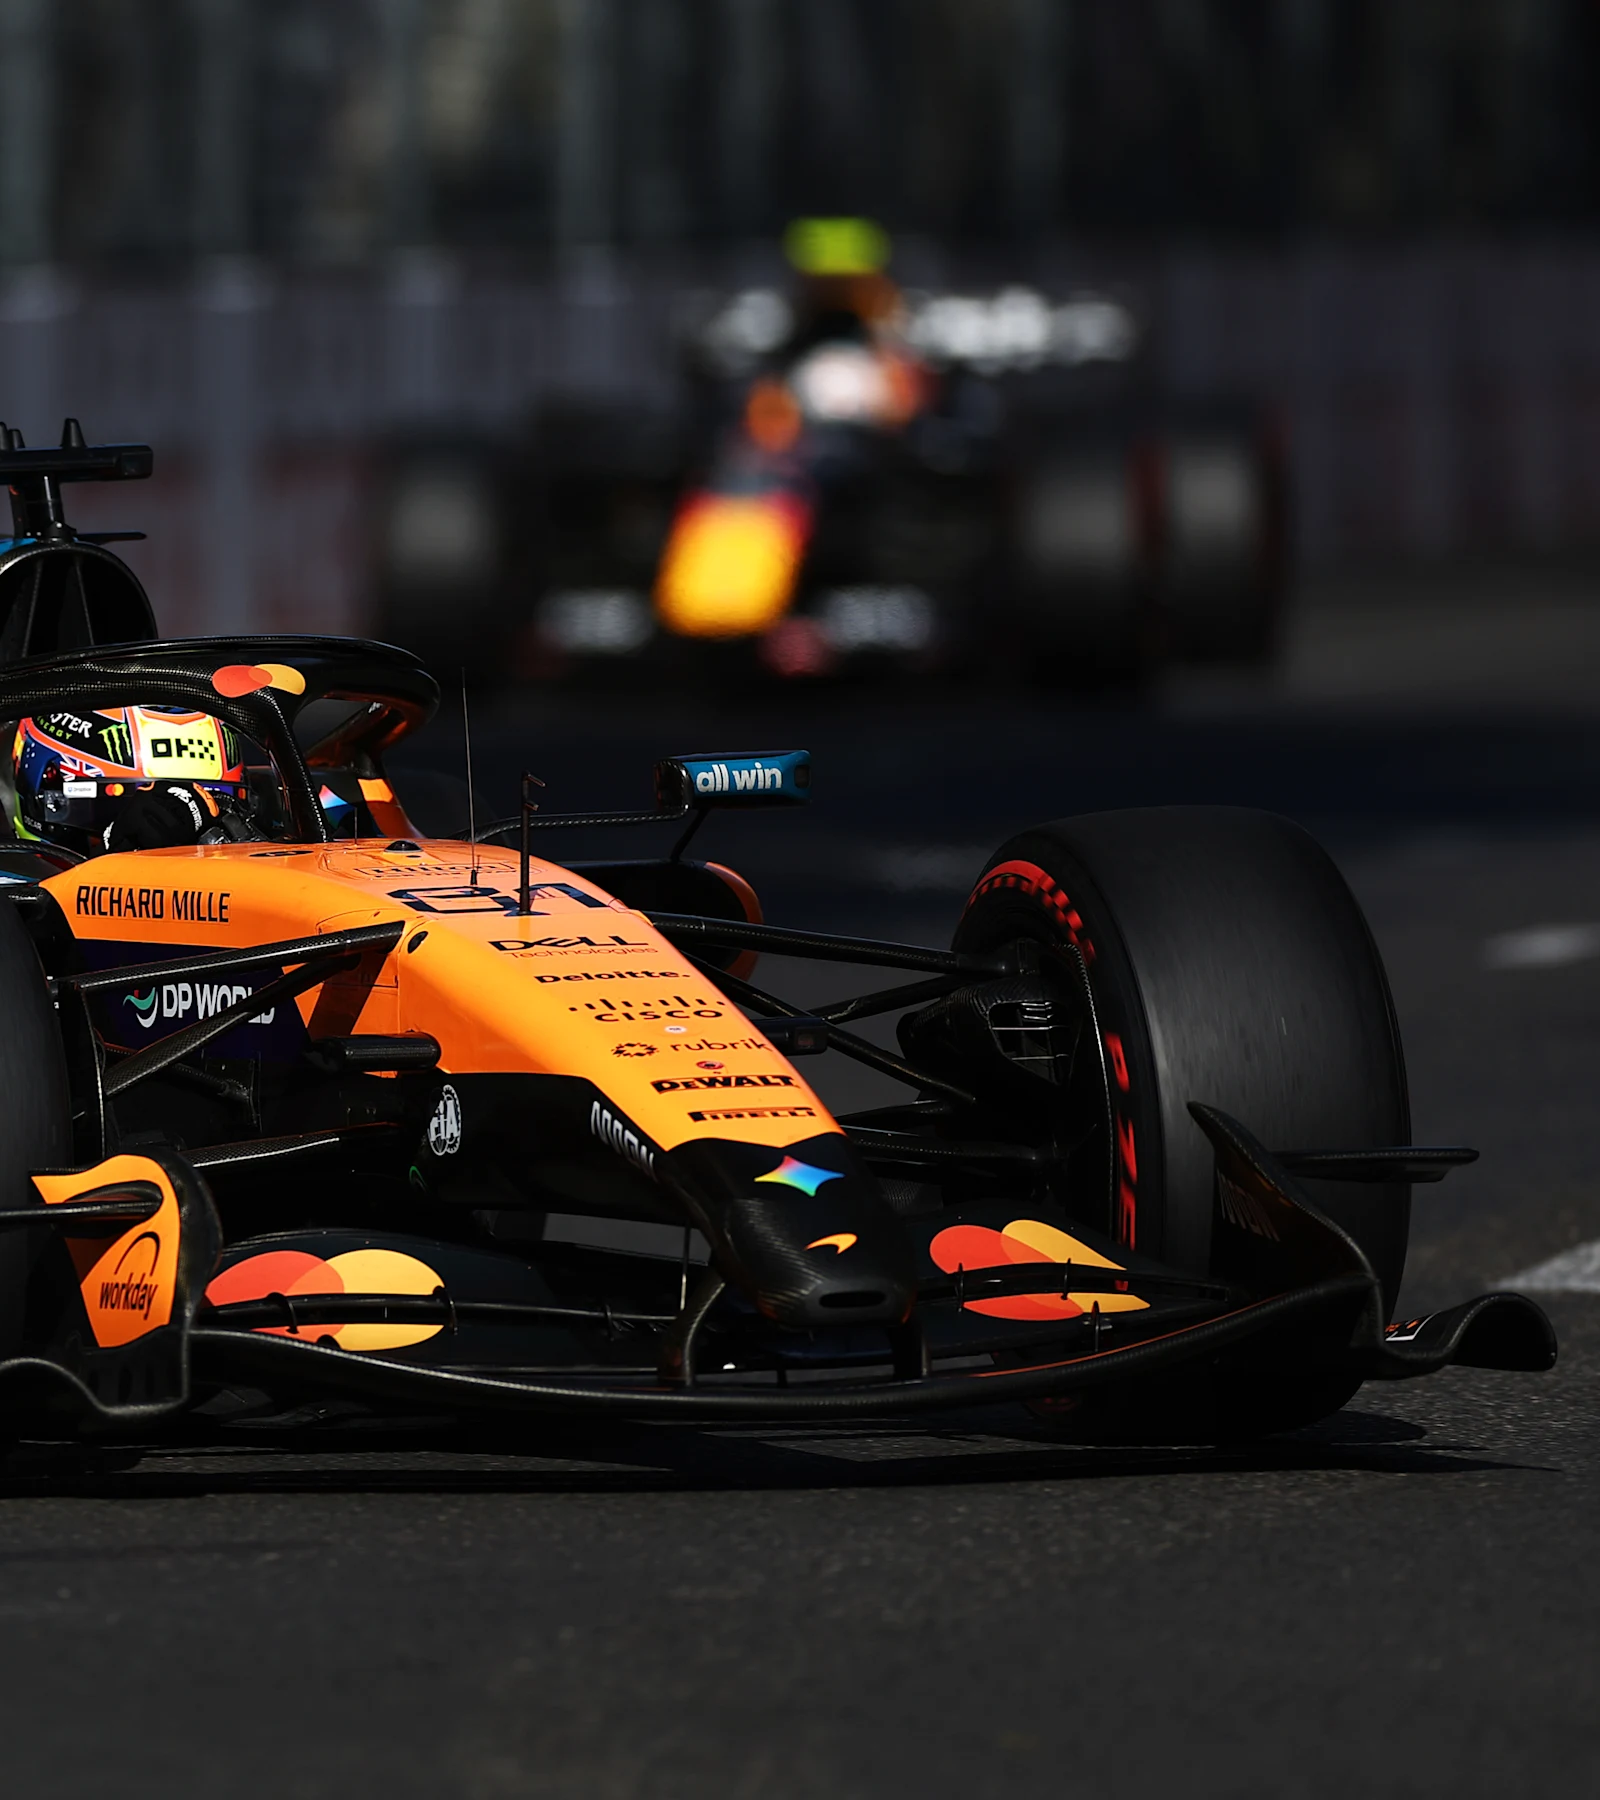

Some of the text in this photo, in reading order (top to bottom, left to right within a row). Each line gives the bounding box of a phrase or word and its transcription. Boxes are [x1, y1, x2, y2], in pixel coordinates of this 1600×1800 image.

[696, 762, 783, 792] all win
[76, 885, 231, 923] RICHARD MILLE
[488, 935, 649, 951] DELL
[504, 947, 659, 959] Technologies
[533, 970, 691, 984] Deloitte.
[162, 982, 193, 1018] DP
[670, 1038, 774, 1052] rubrik
[688, 1107, 818, 1123] PIRELLI
[100, 1272, 158, 1321] workday
